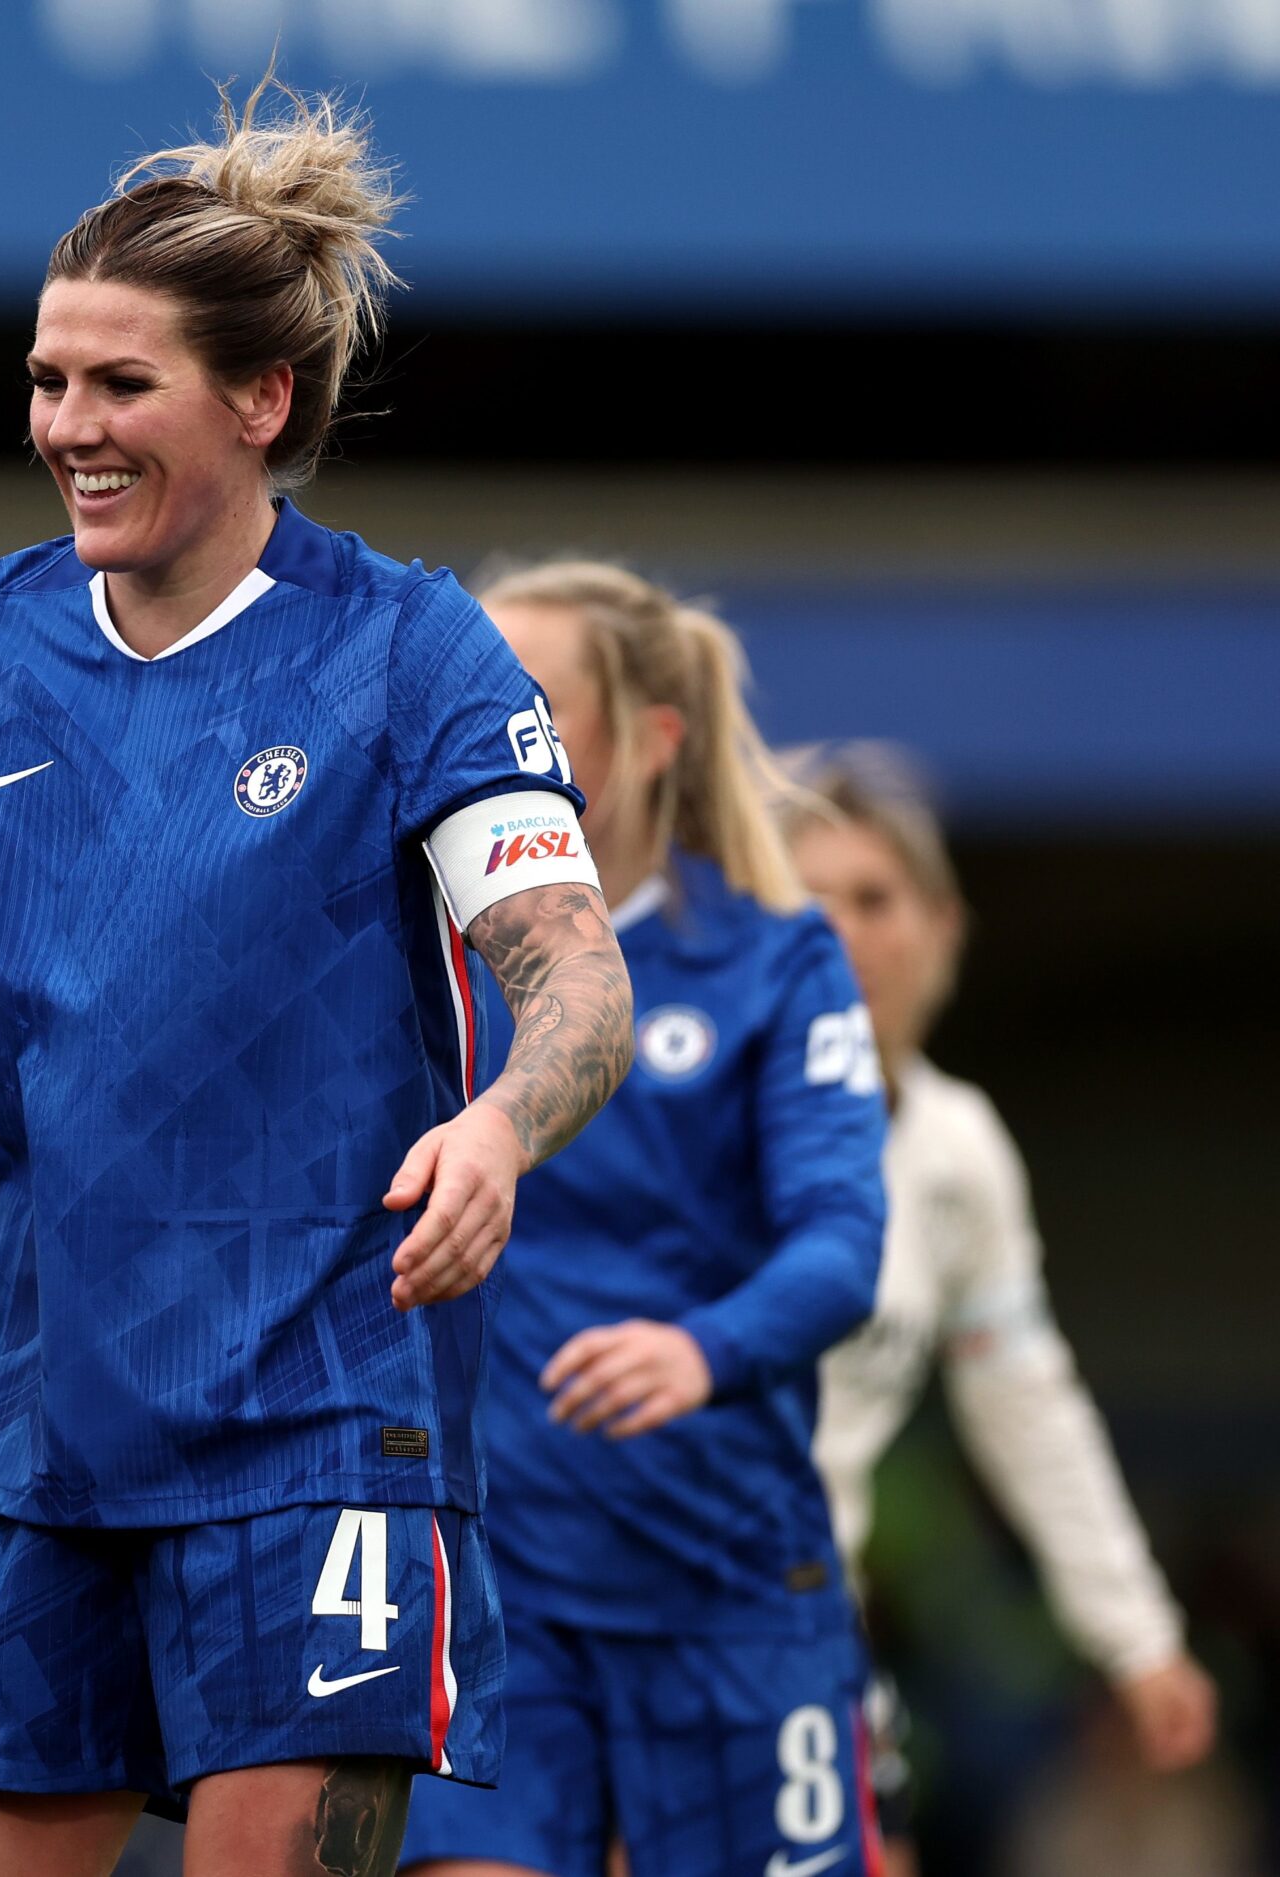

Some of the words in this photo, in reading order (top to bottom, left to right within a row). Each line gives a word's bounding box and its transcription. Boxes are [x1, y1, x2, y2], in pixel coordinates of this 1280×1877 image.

[257, 749, 301, 763] CHELSEA
[243, 800, 270, 813] FOOTBALL
[506, 815, 568, 832] BARCLAYS
[483, 830, 579, 877] WSL
[311, 1508, 399, 1651] 4
[774, 1703, 845, 1845] 8
